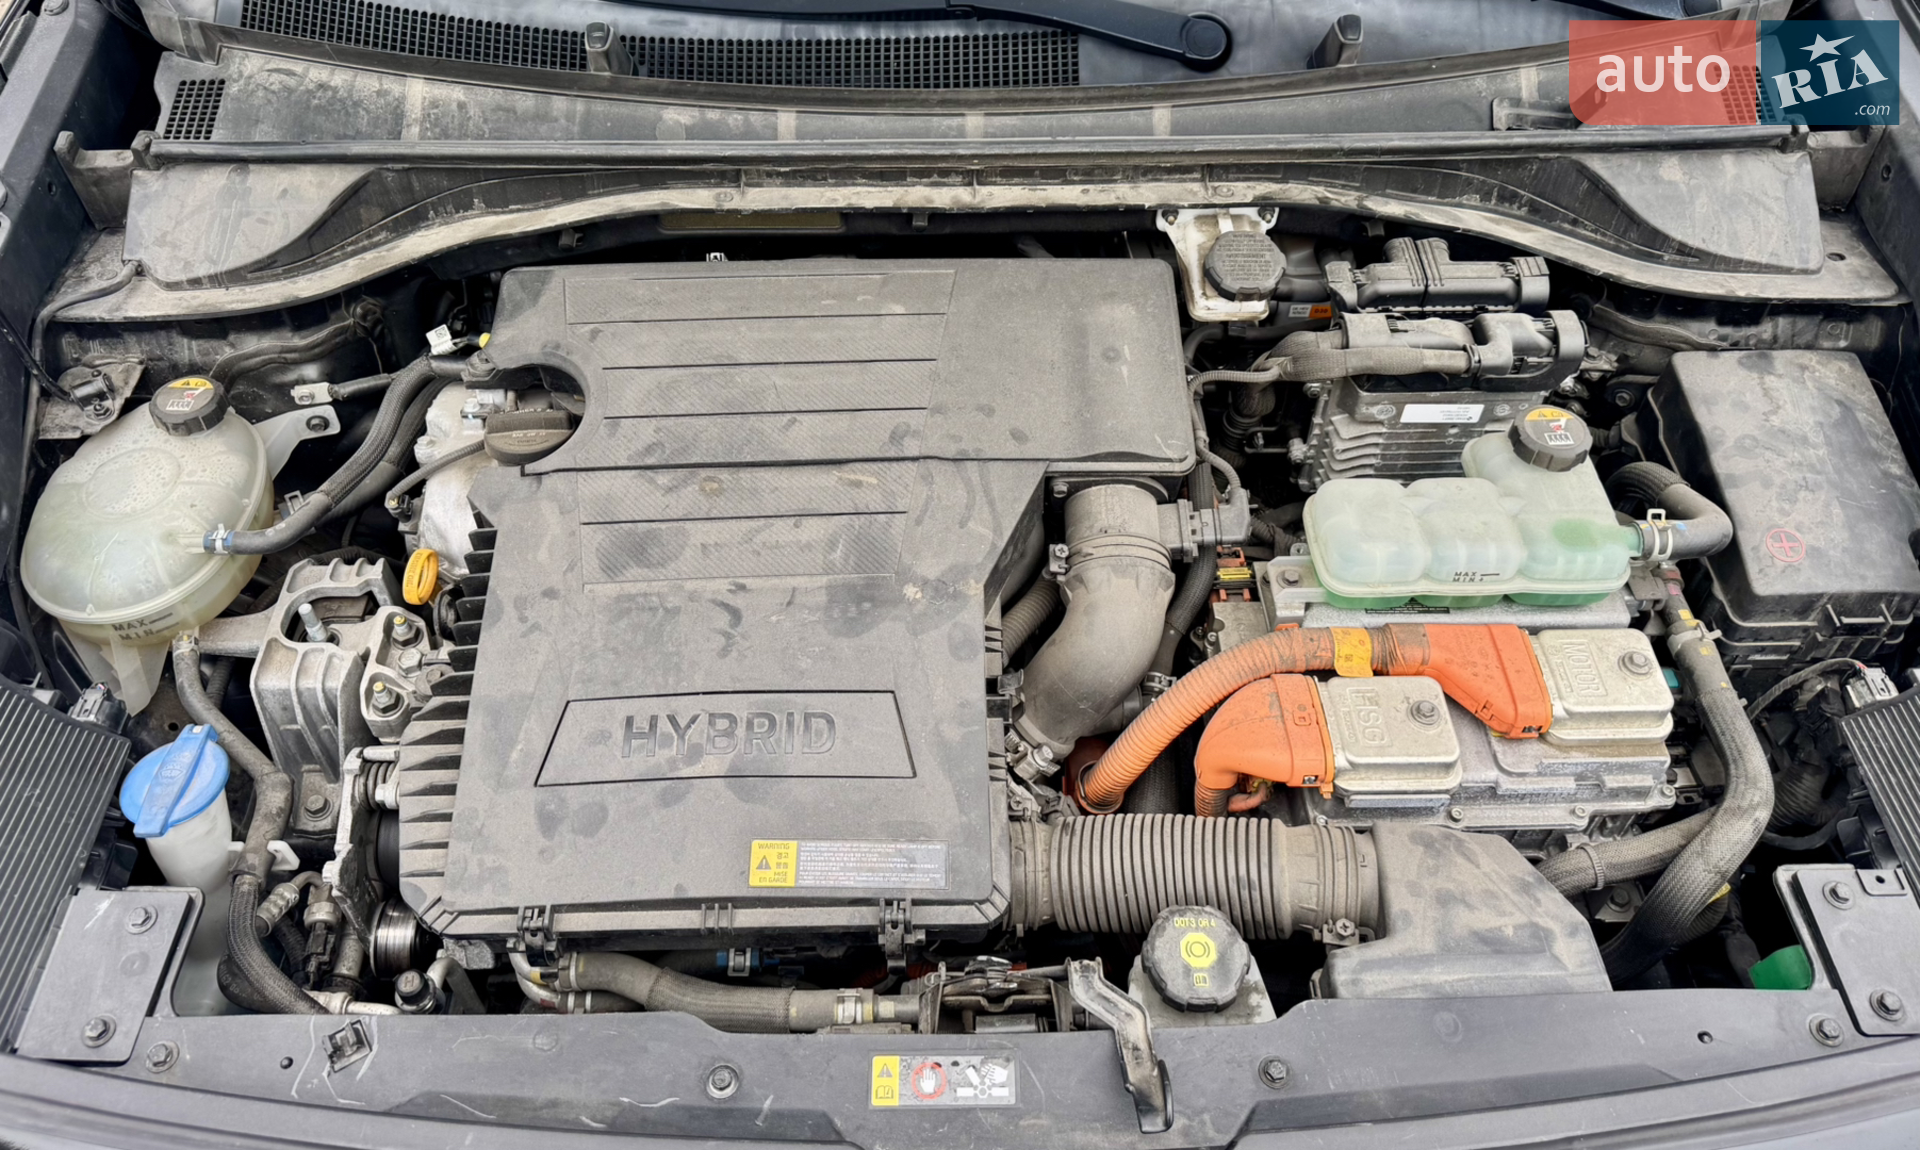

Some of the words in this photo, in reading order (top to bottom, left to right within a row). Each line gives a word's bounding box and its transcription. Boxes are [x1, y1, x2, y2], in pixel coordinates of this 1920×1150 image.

[111, 619, 149, 632] MAX
[118, 628, 156, 641] MIN
[1563, 643, 1600, 693] MOTOR
[621, 710, 836, 758] HYBRID
[1351, 692, 1387, 744] HSG
